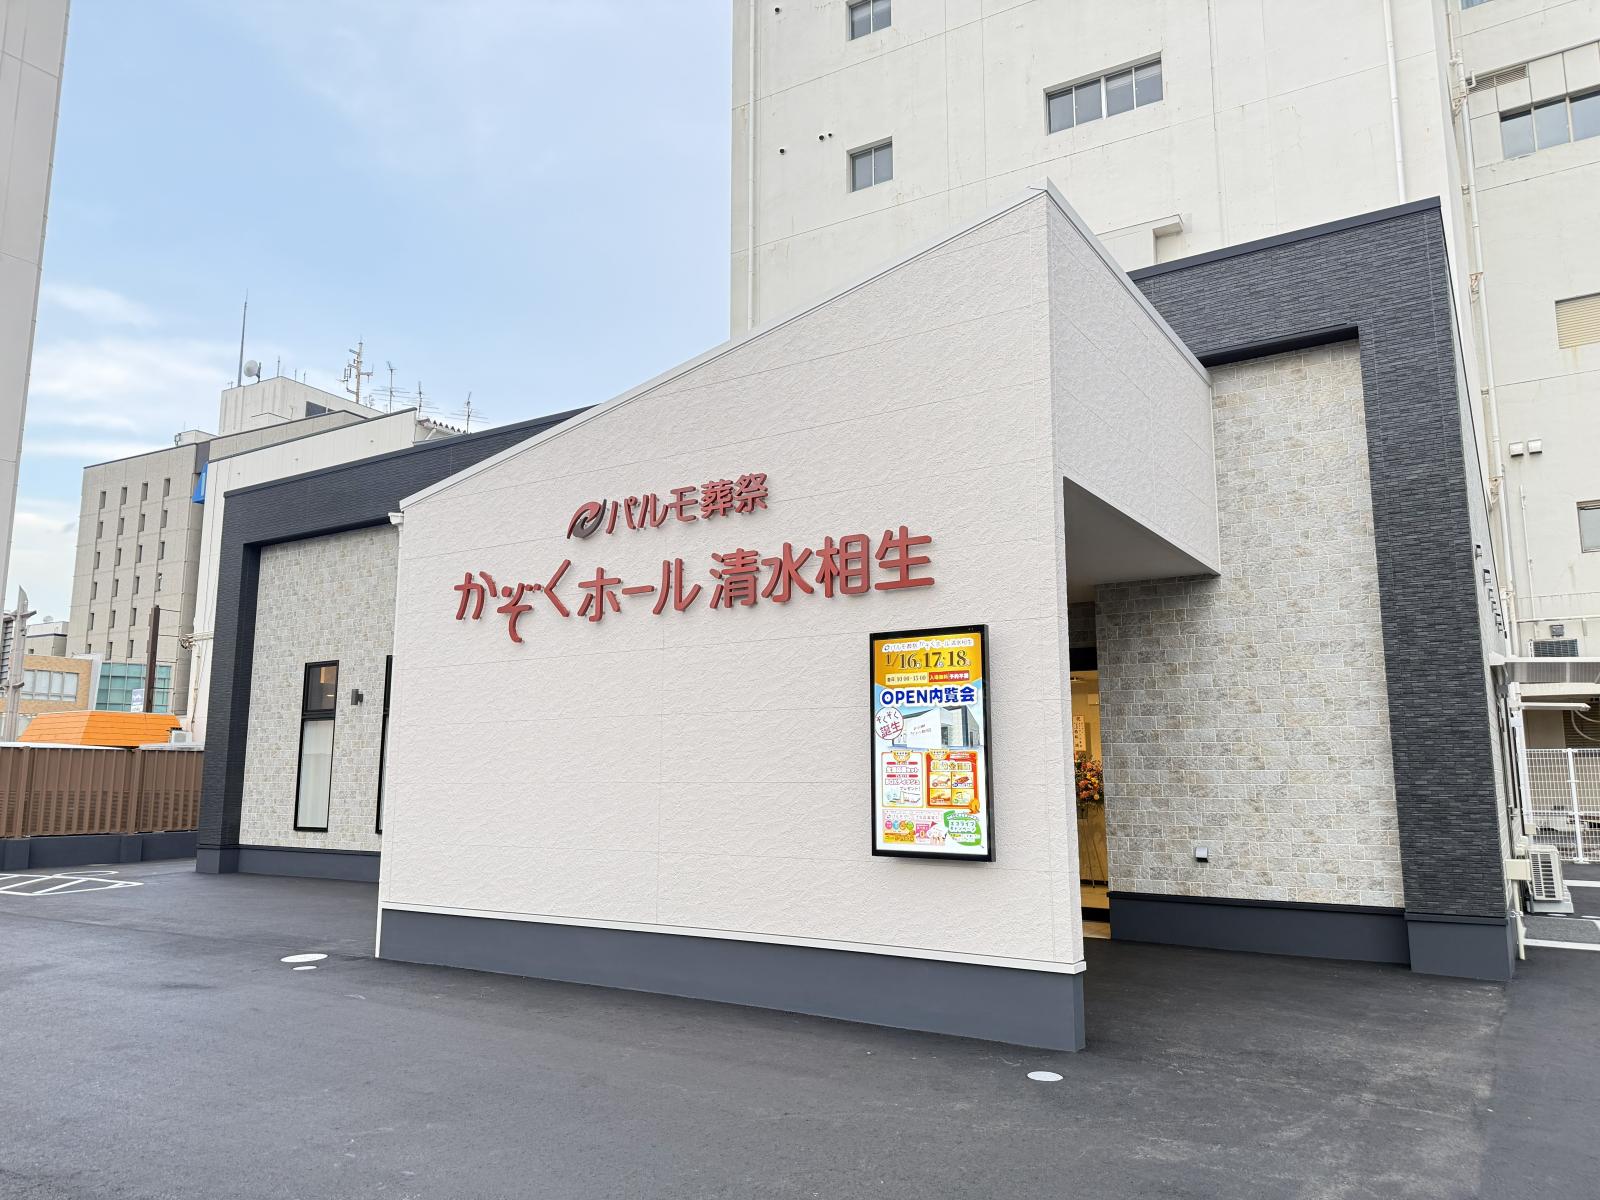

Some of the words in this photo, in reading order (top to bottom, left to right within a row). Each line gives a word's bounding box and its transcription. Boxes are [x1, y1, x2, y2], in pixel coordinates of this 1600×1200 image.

[606, 472, 769, 534] パルモ葬祭
[454, 525, 935, 643] かぞくホール清水相生
[881, 686, 975, 705] OPEN内覧会
